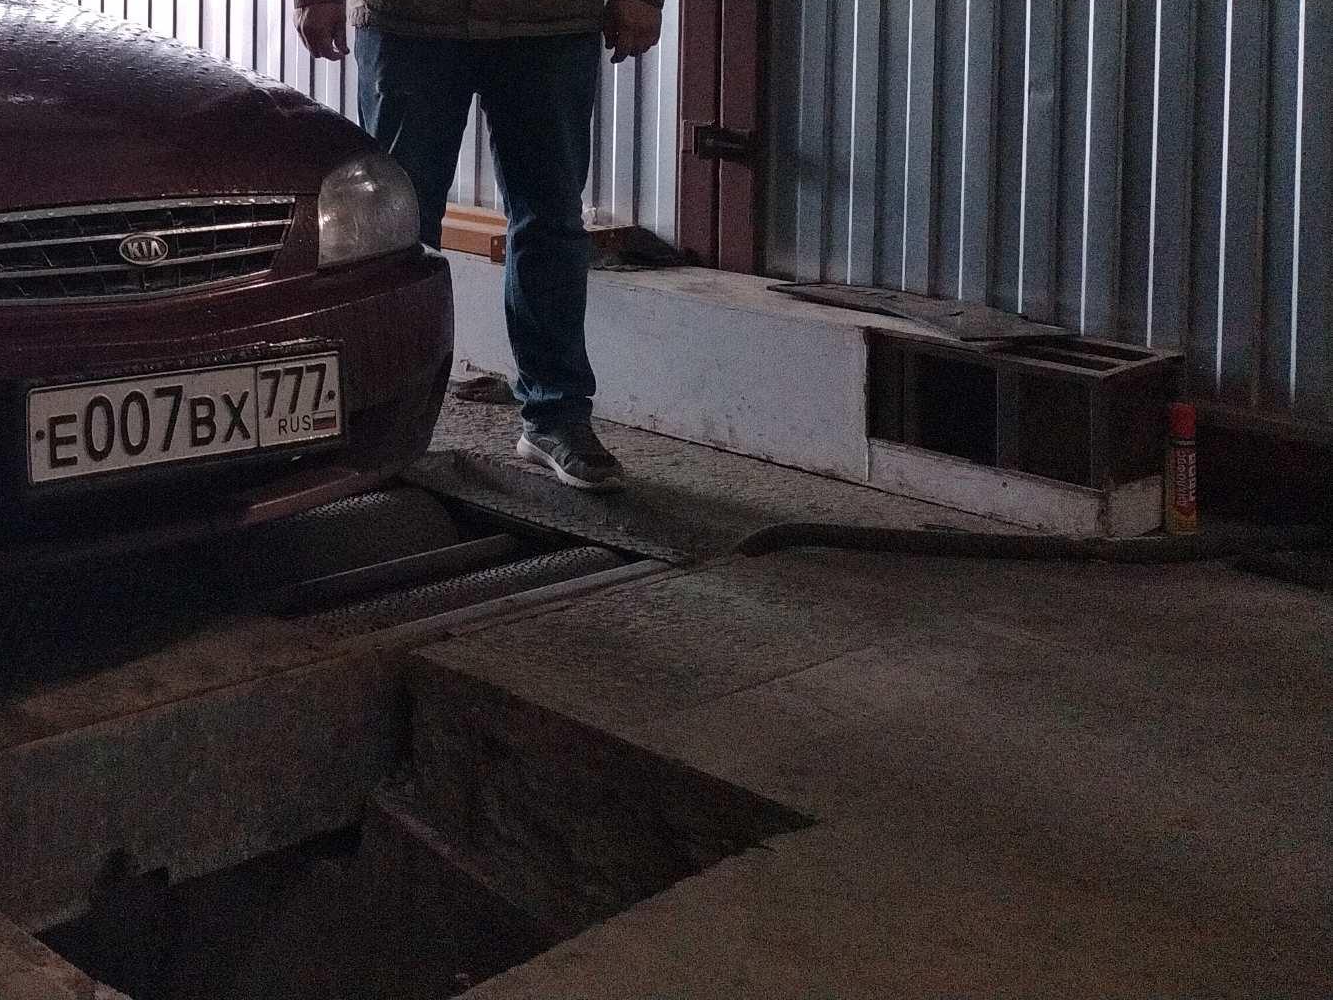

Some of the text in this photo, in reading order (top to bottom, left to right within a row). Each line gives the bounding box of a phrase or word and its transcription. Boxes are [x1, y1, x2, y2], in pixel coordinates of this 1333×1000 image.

[127, 240, 163, 258] KIA
[48, 363, 328, 469] E007BX 777
[277, 414, 312, 436] RUS
